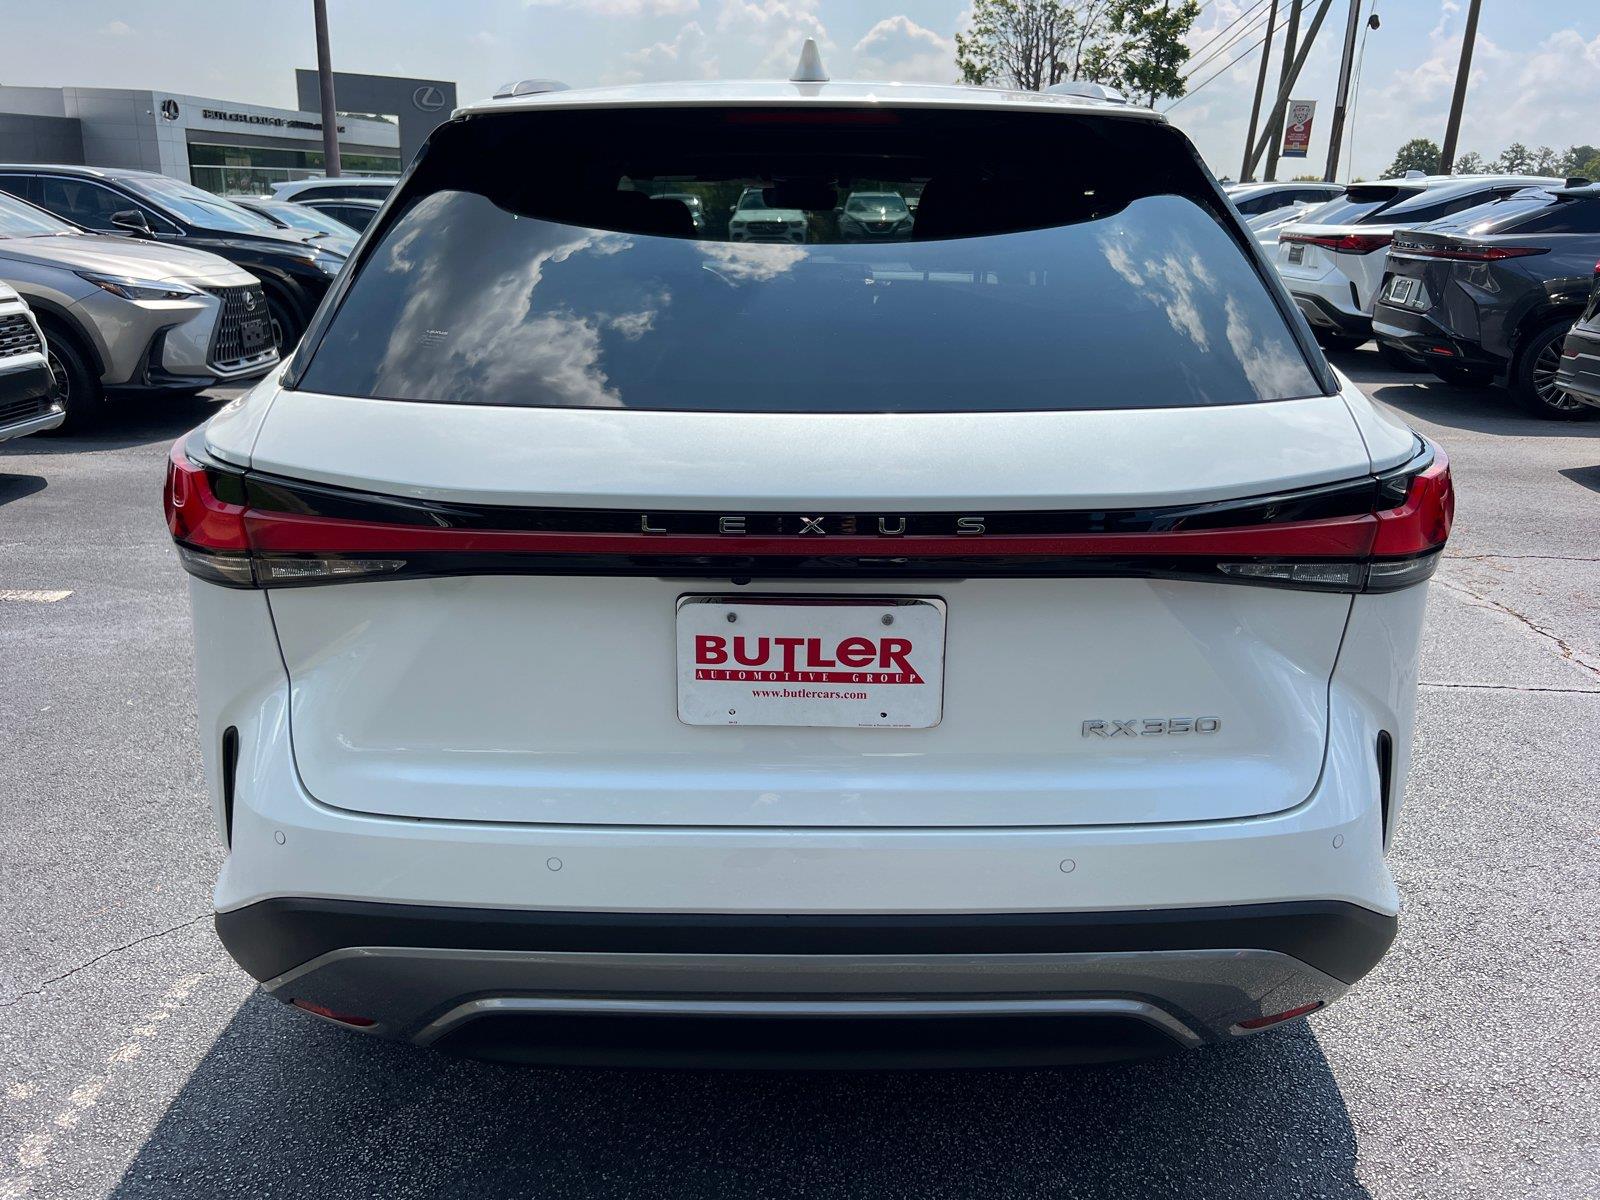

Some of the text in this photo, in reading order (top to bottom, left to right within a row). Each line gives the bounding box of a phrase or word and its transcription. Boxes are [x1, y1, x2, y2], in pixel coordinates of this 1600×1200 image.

[641, 515, 986, 534] LEXUS
[697, 670, 917, 683] AUTOMOTIVE GROUP
[752, 688, 867, 700] BUTLeR
